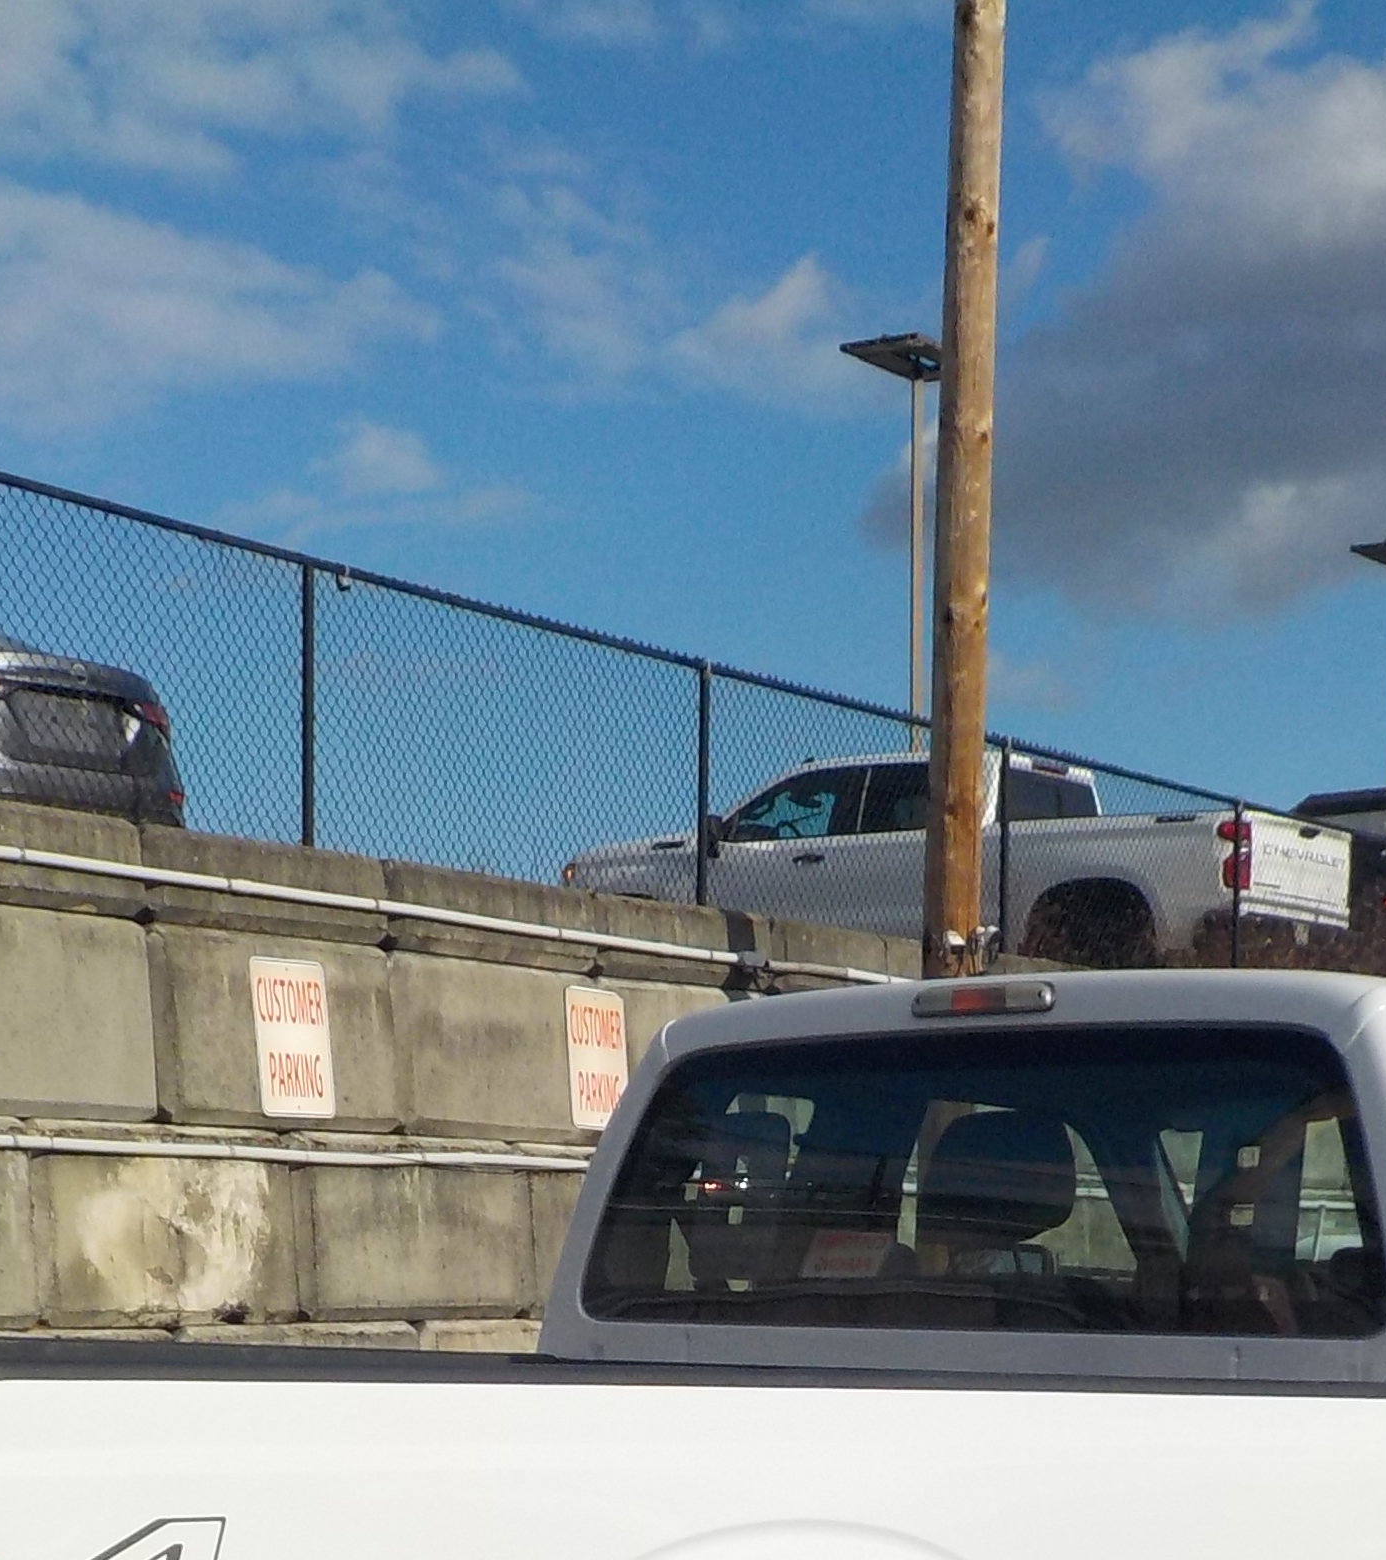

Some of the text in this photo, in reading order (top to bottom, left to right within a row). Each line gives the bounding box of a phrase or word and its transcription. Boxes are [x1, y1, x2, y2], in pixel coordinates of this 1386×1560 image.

[257, 977, 323, 1025] CUSTOMER
[570, 1004, 622, 1049] CUSTOMER
[268, 1052, 324, 1100] PARKING
